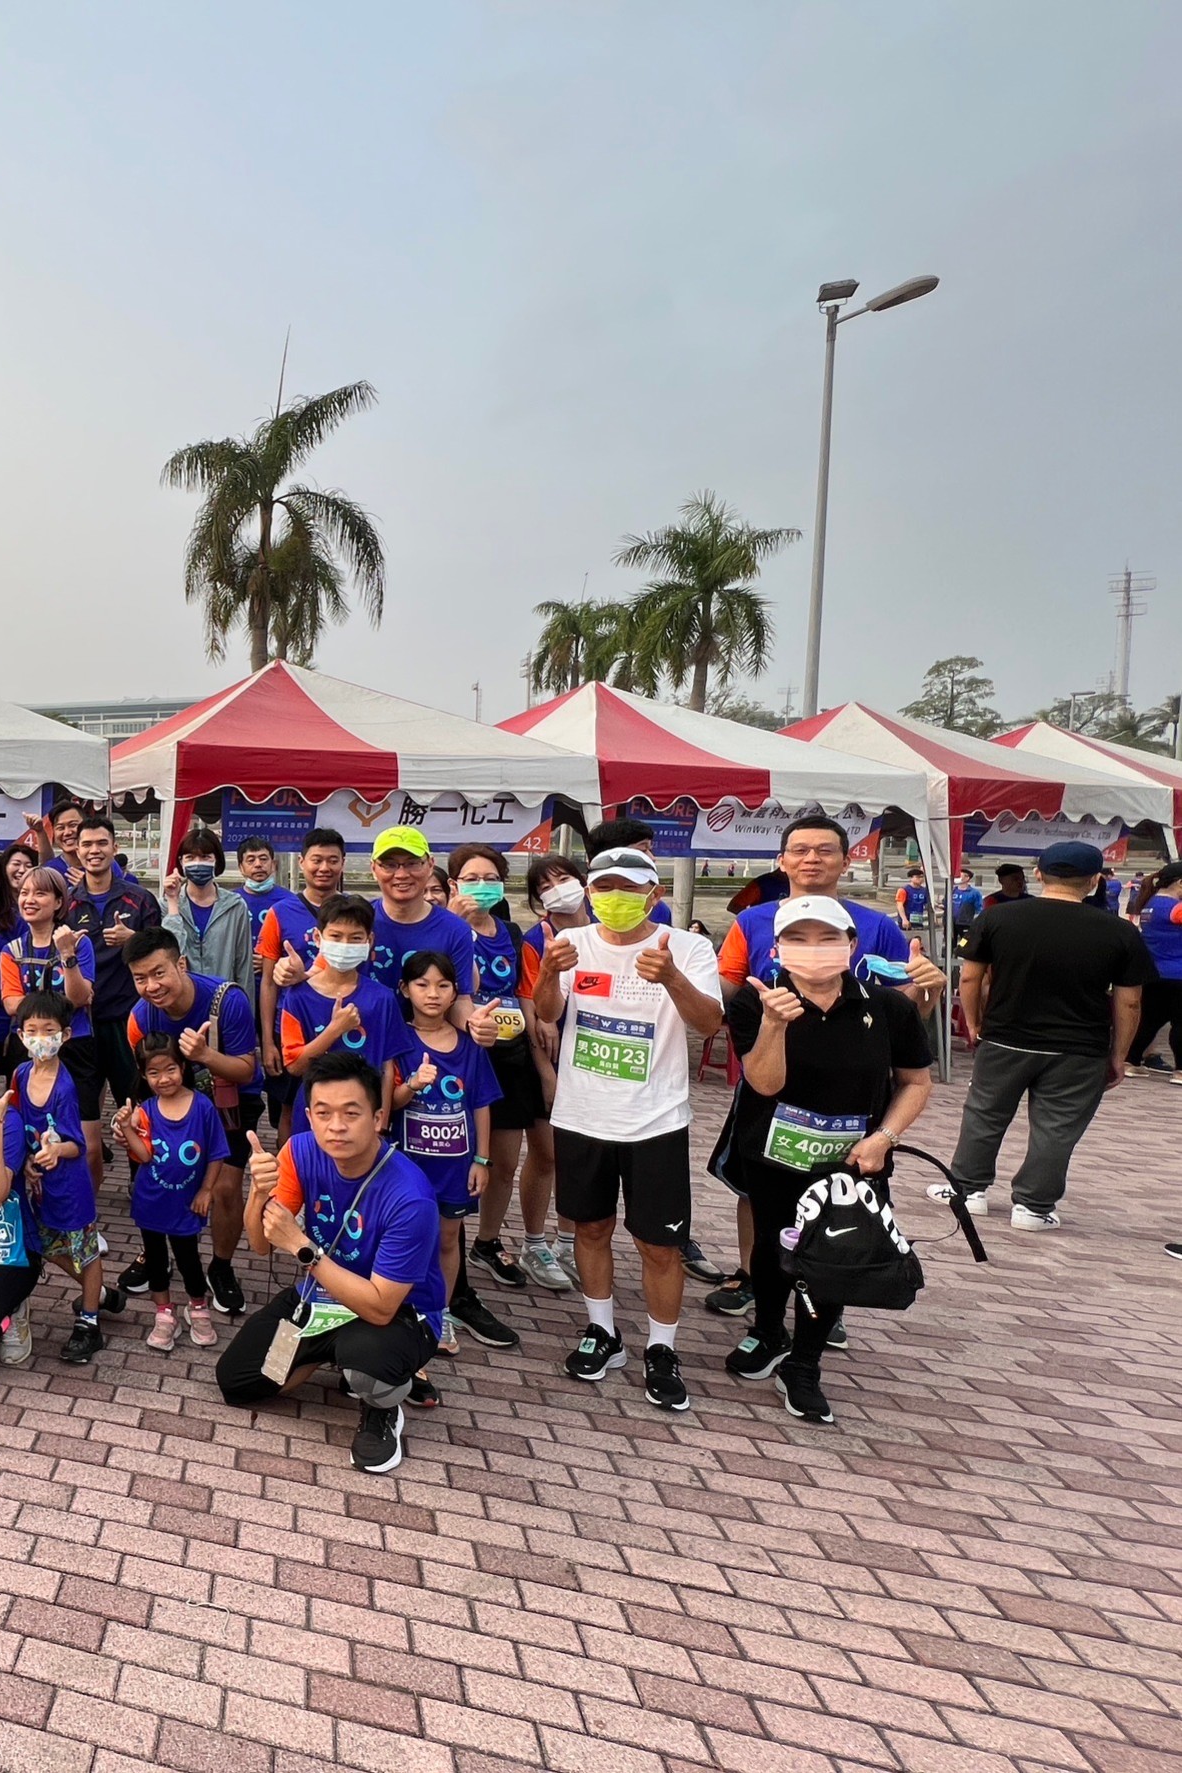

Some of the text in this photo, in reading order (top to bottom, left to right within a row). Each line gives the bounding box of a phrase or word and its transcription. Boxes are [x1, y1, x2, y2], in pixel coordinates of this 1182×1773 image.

[398, 796, 515, 826] 勝一化工
[735, 824, 771, 836] WinWay
[523, 836, 541, 850] 42
[852, 845, 868, 857] 43
[494, 1014, 521, 1026] 005
[577, 1039, 589, 1054] 男
[589, 1041, 646, 1065] 30123
[420, 1122, 466, 1140] 80024
[774, 1134, 793, 1149] 女
[311, 1225, 325, 1243] RUN
